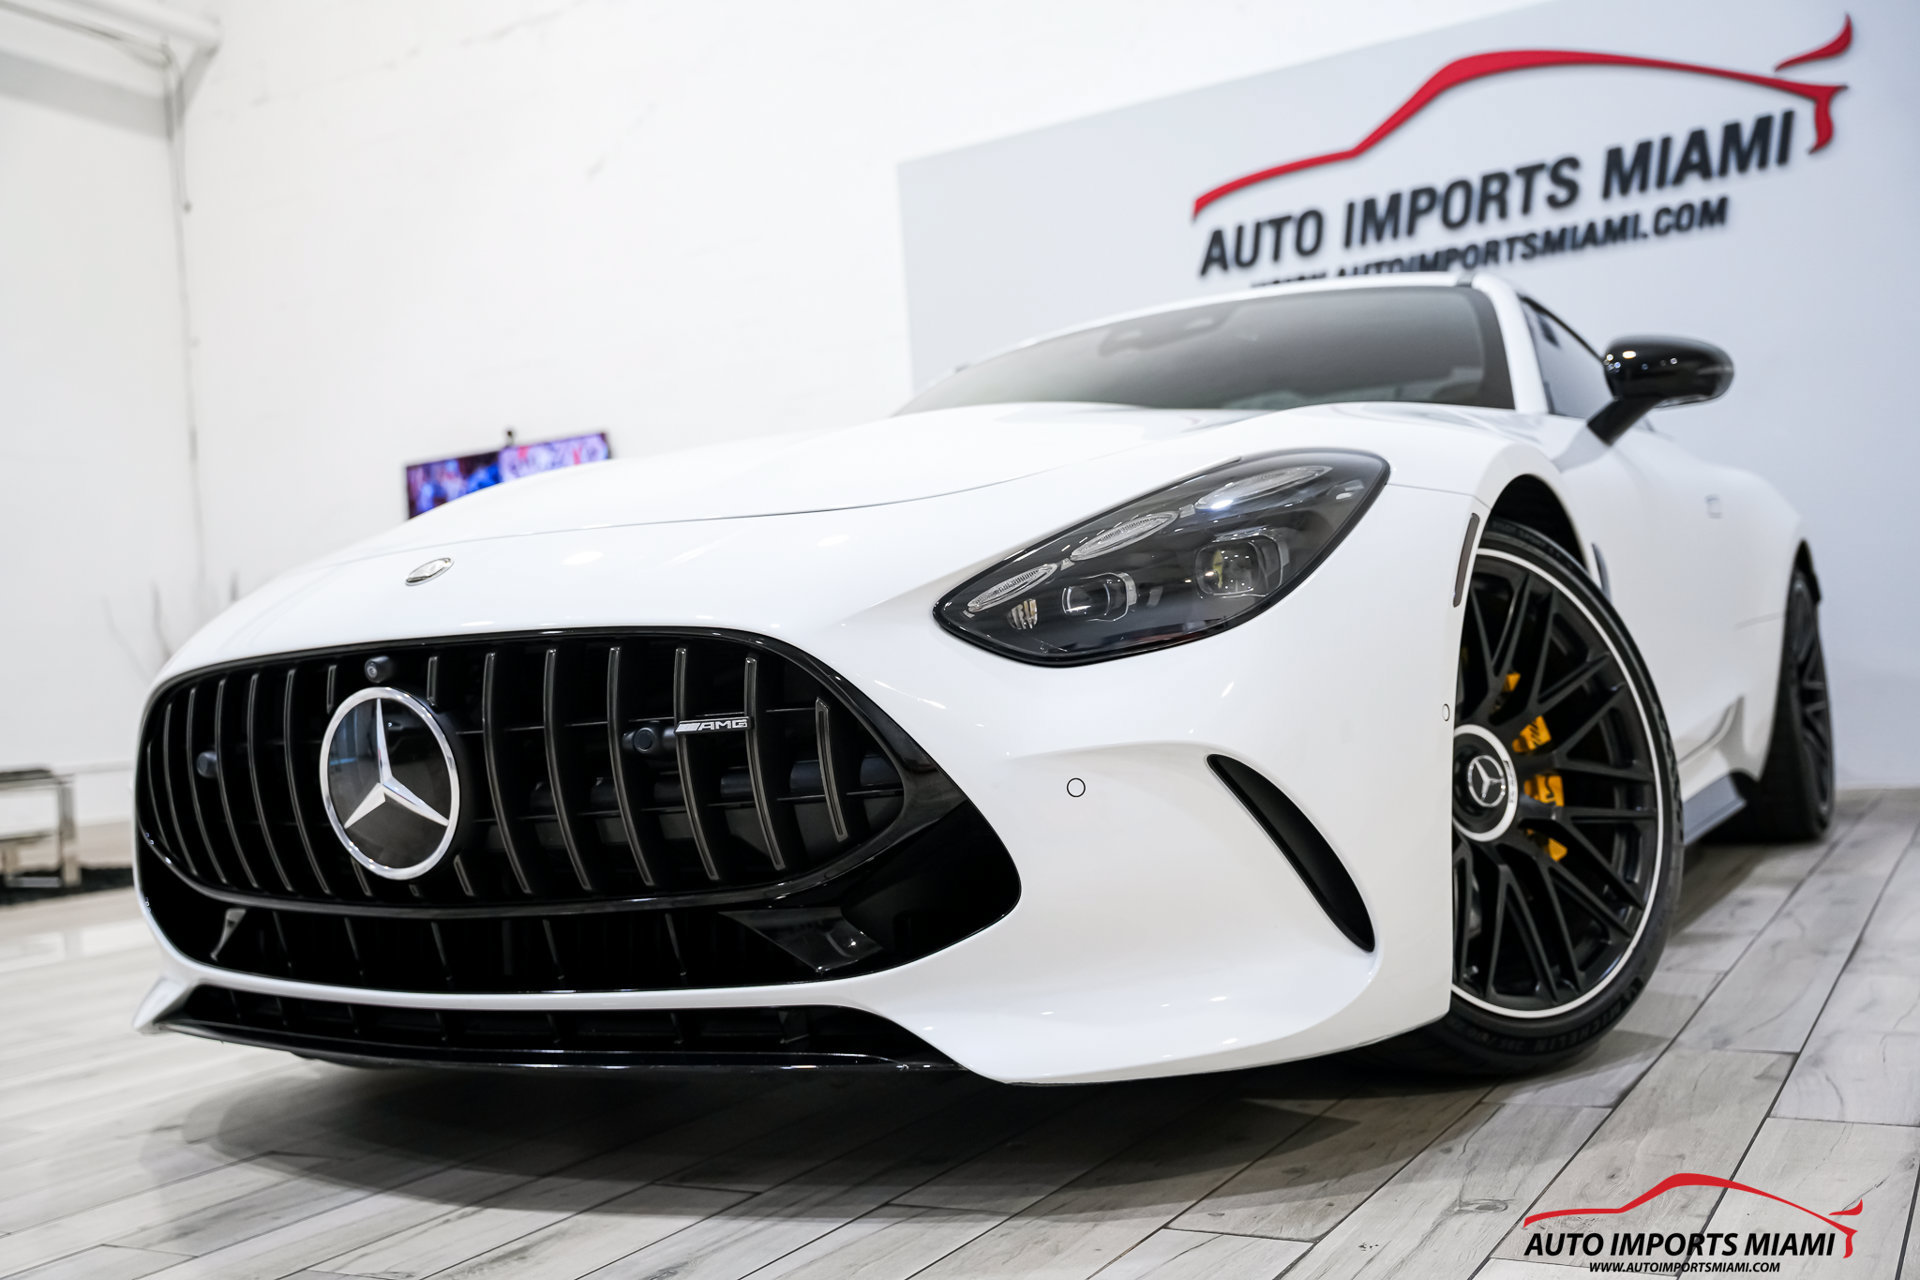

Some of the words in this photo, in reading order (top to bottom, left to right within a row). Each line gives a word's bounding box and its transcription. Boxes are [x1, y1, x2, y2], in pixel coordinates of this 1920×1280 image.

[1199, 209, 1324, 277] AUTO
[1343, 156, 1581, 249] IMPORTS
[1602, 109, 1795, 201] MIAMI
[698, 719, 748, 731] AMG
[1533, 1000, 1623, 1053] MICHELIN
